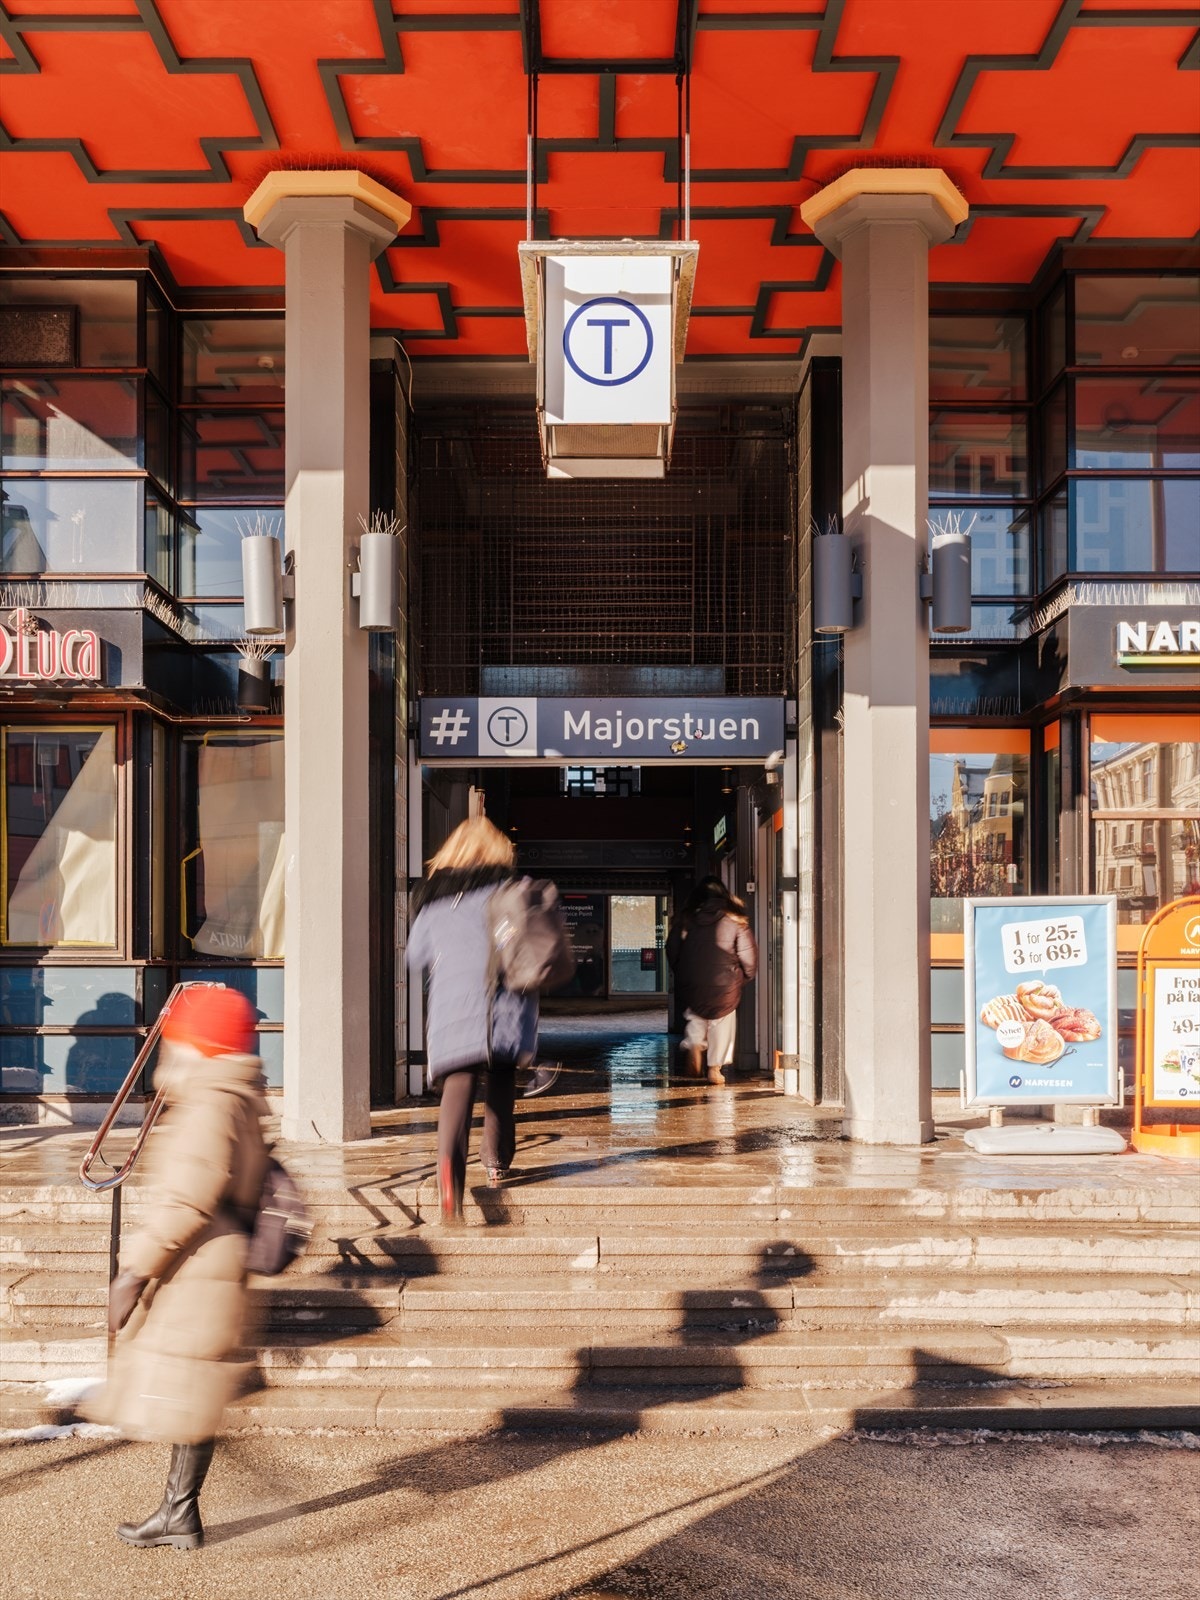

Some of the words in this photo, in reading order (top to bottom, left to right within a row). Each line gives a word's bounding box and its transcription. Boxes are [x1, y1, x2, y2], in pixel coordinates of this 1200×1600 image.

[1117, 621, 1200, 652] NAR
[563, 710, 760, 748] Majorstuen
[1014, 930, 1021, 945] 1
[1027, 932, 1040, 944] for
[1013, 949, 1025, 965] 3
[1029, 951, 1042, 963] for
[1174, 977, 1200, 989] Fro
[1167, 990, 1184, 1005] på
[1024, 1079, 1073, 1087] NARVESEN
